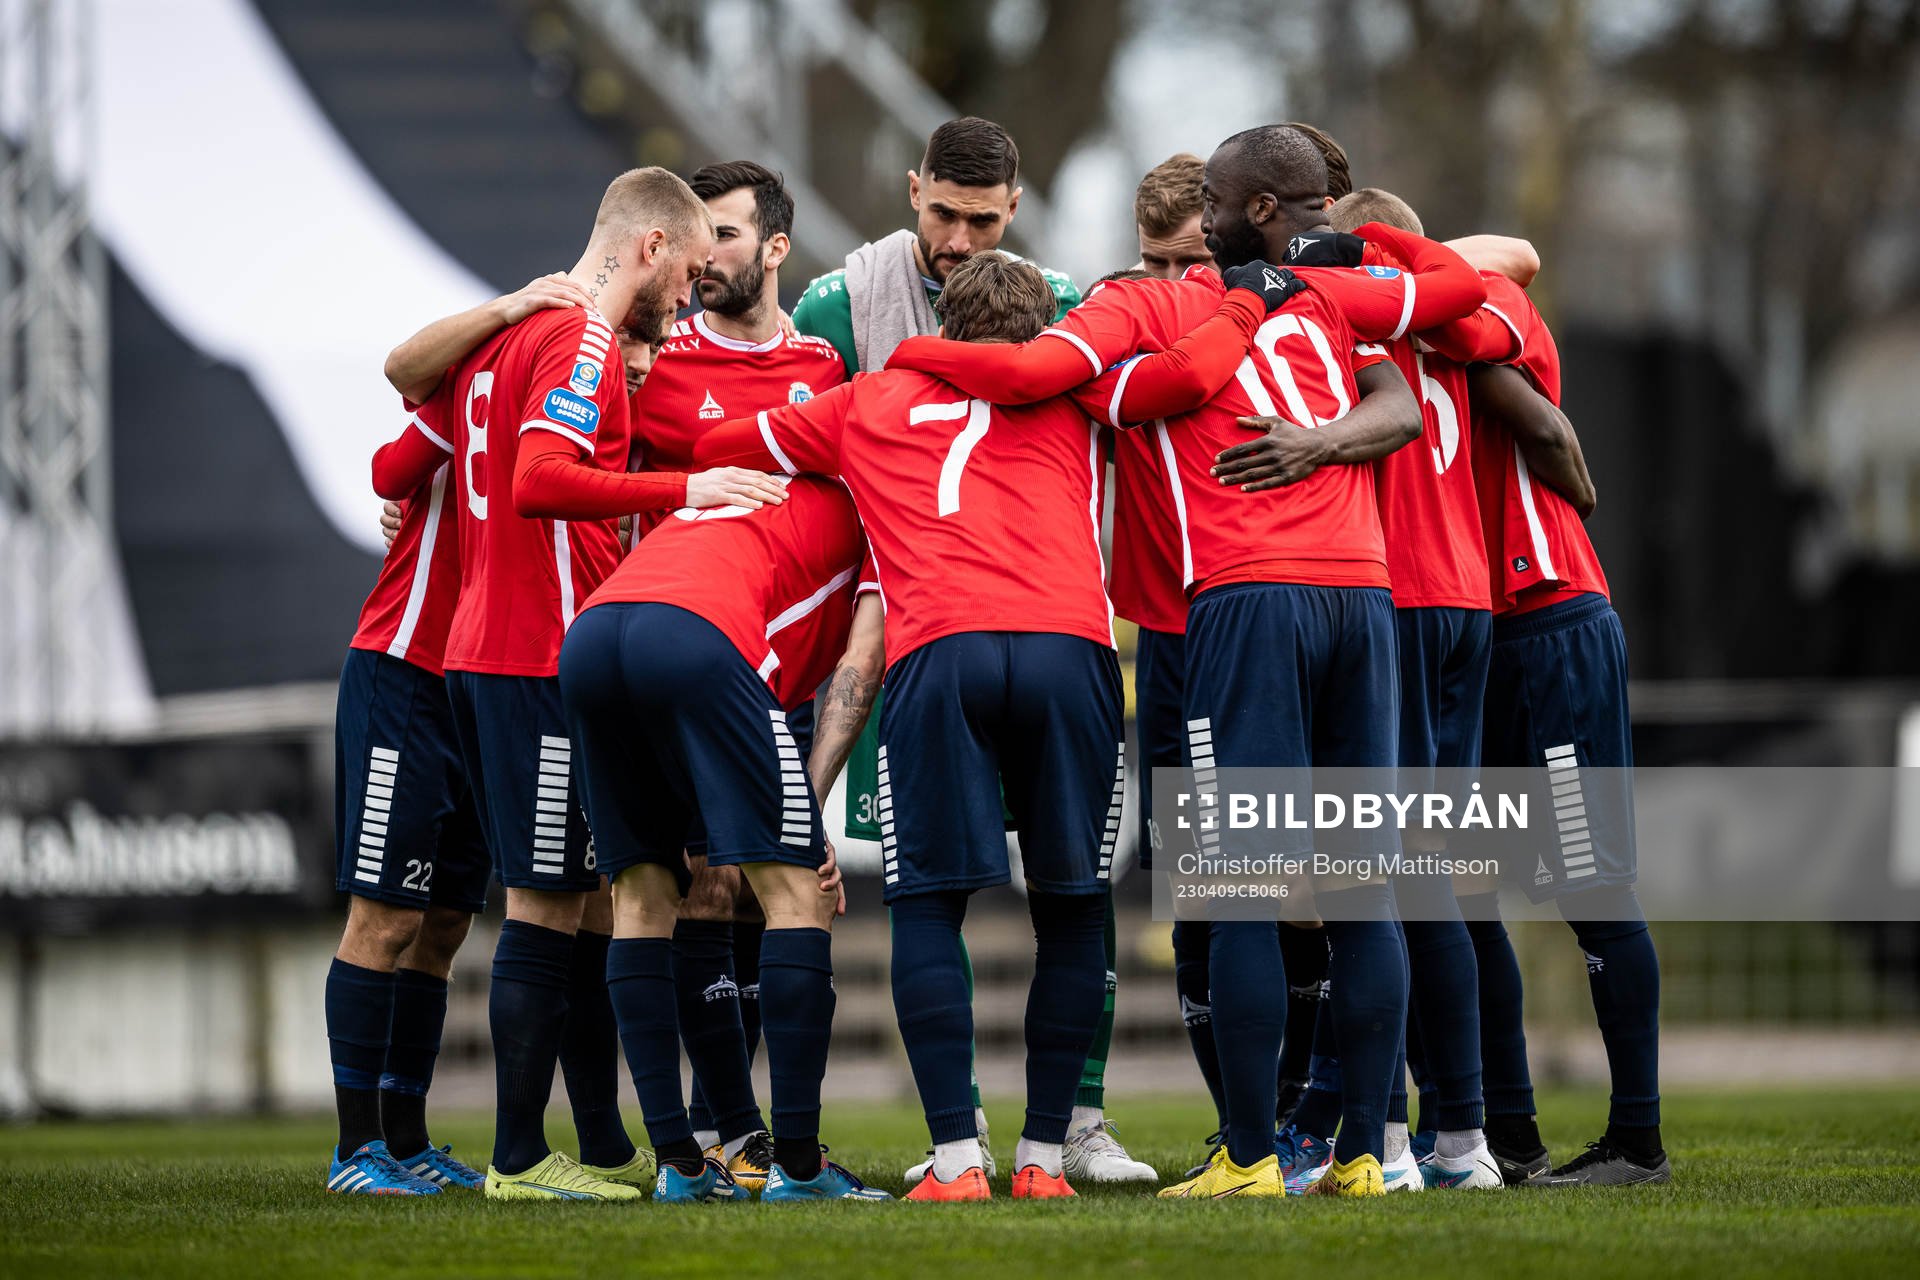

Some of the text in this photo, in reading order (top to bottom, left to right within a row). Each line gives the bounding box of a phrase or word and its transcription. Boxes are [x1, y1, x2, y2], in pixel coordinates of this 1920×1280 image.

[550, 394, 596, 421] UNIBET
[1234, 313, 1351, 429] 10
[909, 398, 991, 518] 7
[401, 858, 433, 892] 22
